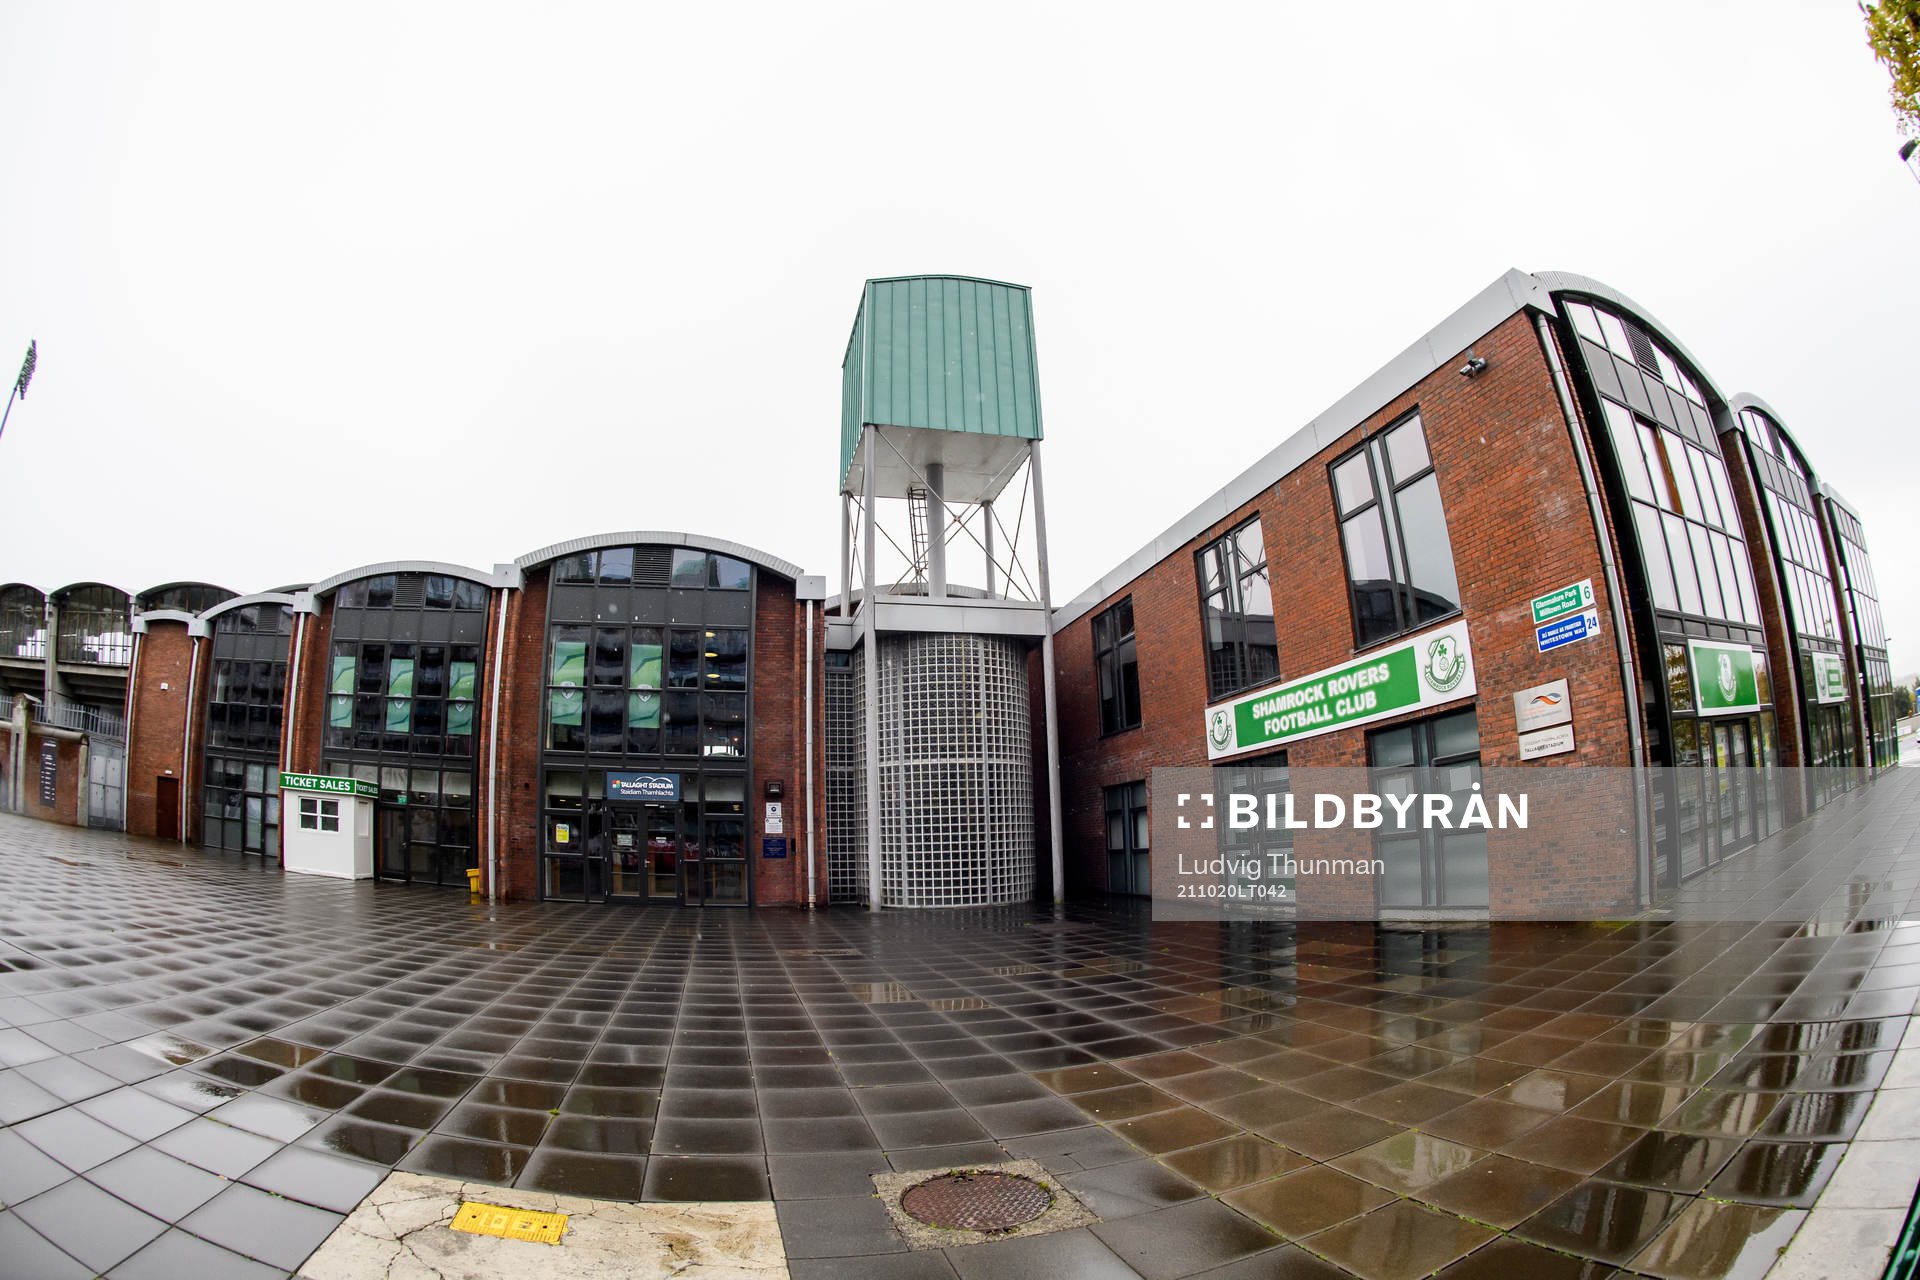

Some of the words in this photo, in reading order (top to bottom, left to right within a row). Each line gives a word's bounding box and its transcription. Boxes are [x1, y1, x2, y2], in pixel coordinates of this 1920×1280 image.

[1564, 588, 1577, 599] Park
[1584, 586, 1591, 599] 6
[1561, 598, 1576, 609] Road
[1586, 616, 1597, 629] 24
[1540, 631, 1573, 646] WHITESTOWN
[1574, 626, 1586, 635] WAY
[1252, 683, 1325, 719] SHAMROCK
[1328, 662, 1390, 697] ROVERS
[1264, 703, 1333, 736] FOOTBALL
[1335, 690, 1377, 717] CLUB
[284, 775, 317, 788] TICKET
[320, 778, 350, 791] SALES
[356, 783, 368, 792] TICKET
[368, 786, 378, 794] SALES
[620, 781, 647, 789] TALLAGHT
